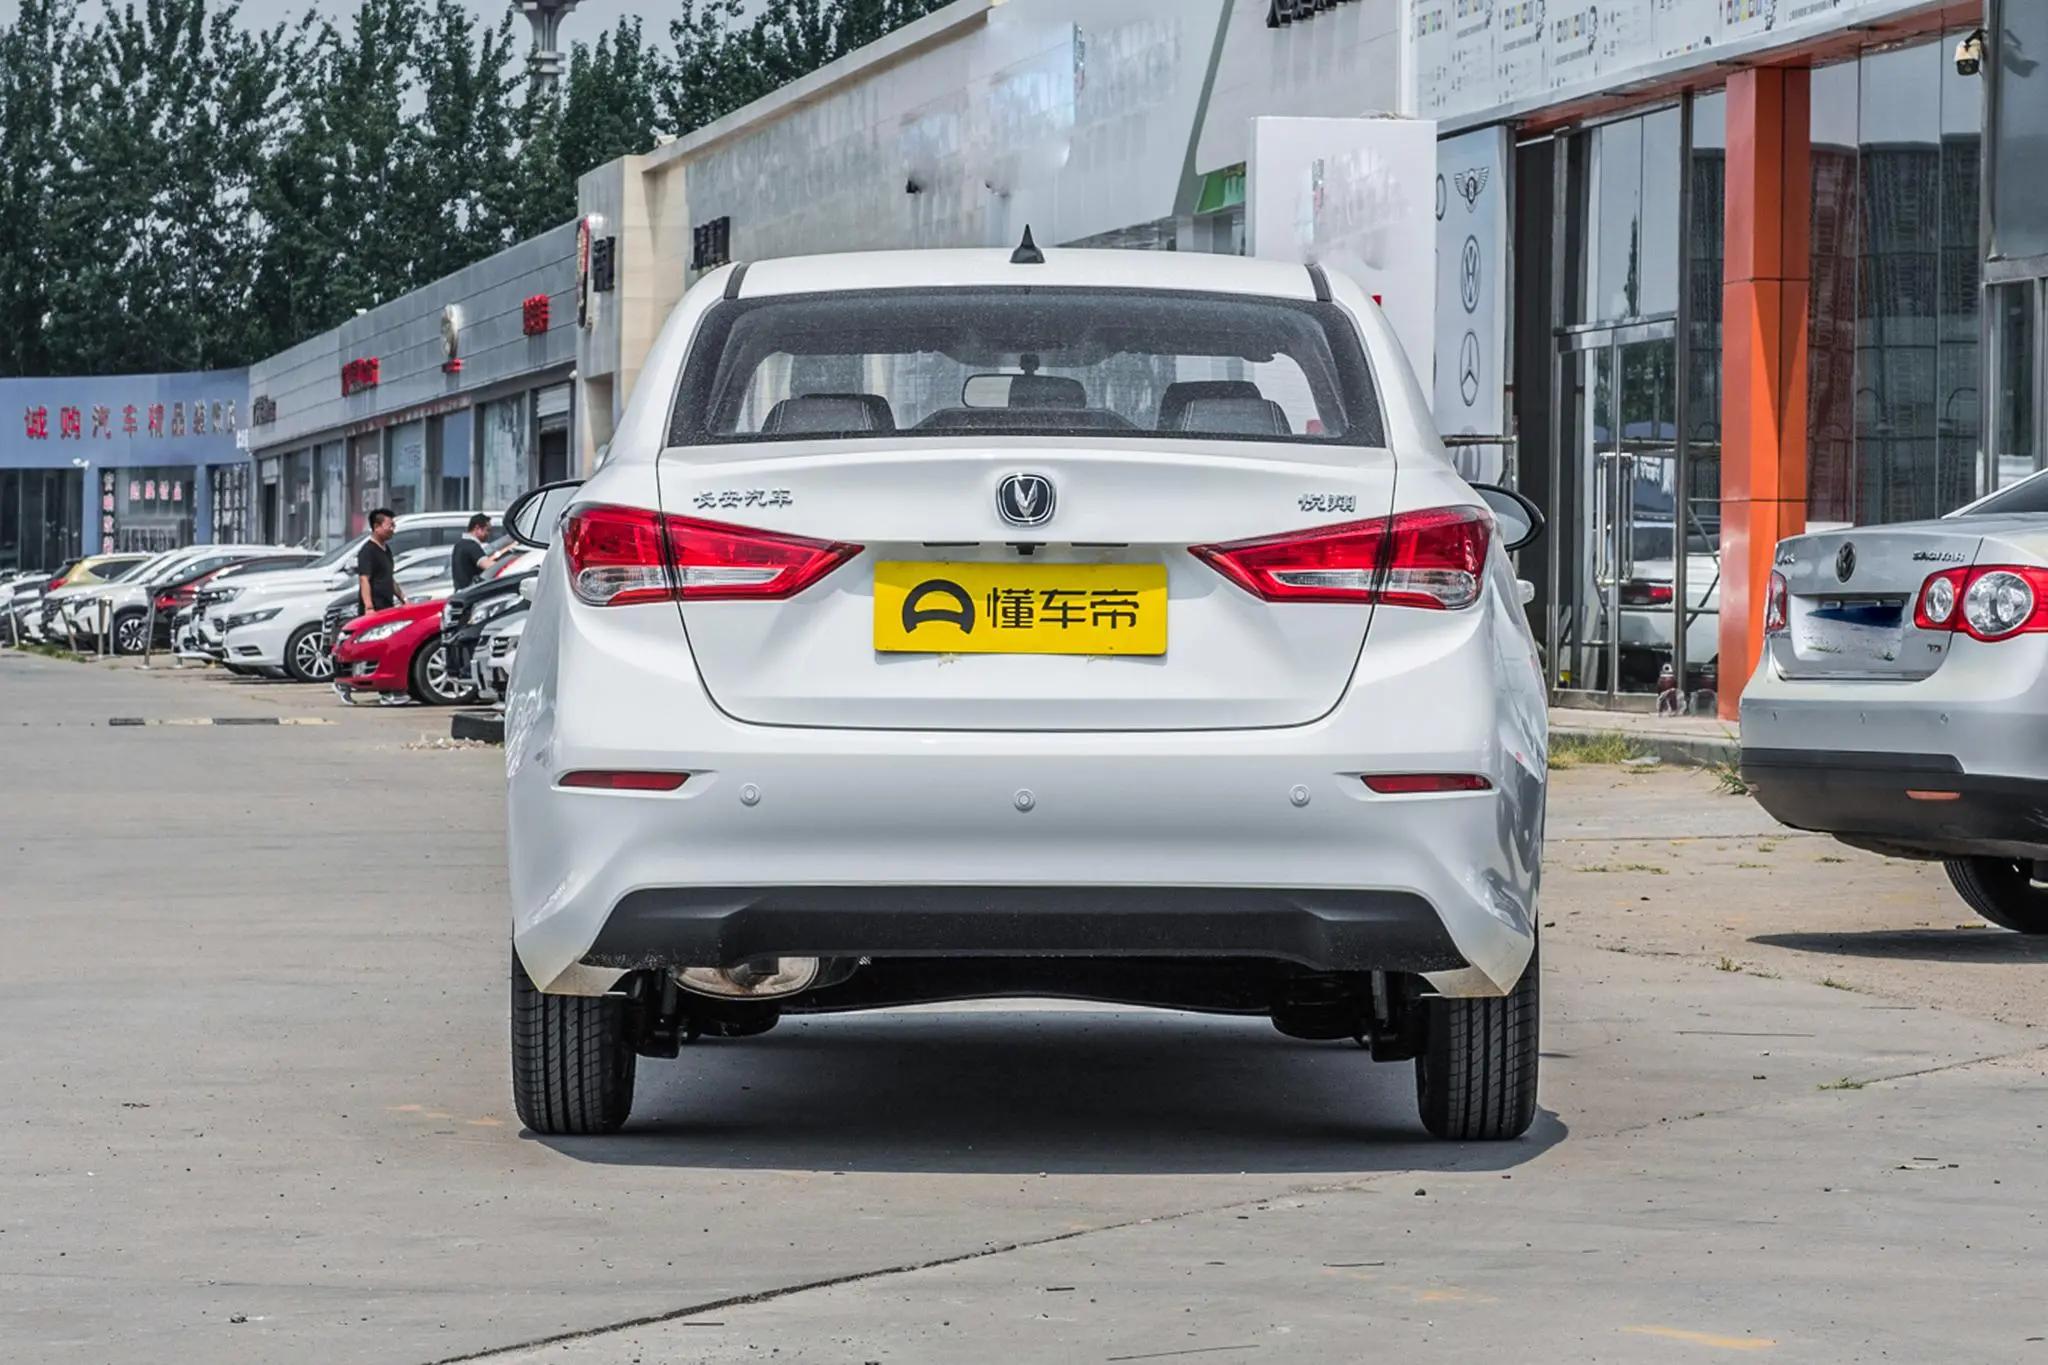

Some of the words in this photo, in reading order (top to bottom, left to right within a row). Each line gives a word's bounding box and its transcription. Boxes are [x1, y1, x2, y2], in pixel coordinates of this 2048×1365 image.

[693, 489, 793, 509] 长安汽车
[1298, 494, 1357, 512] 悦翔
[987, 587, 1140, 629] 懂车帝
